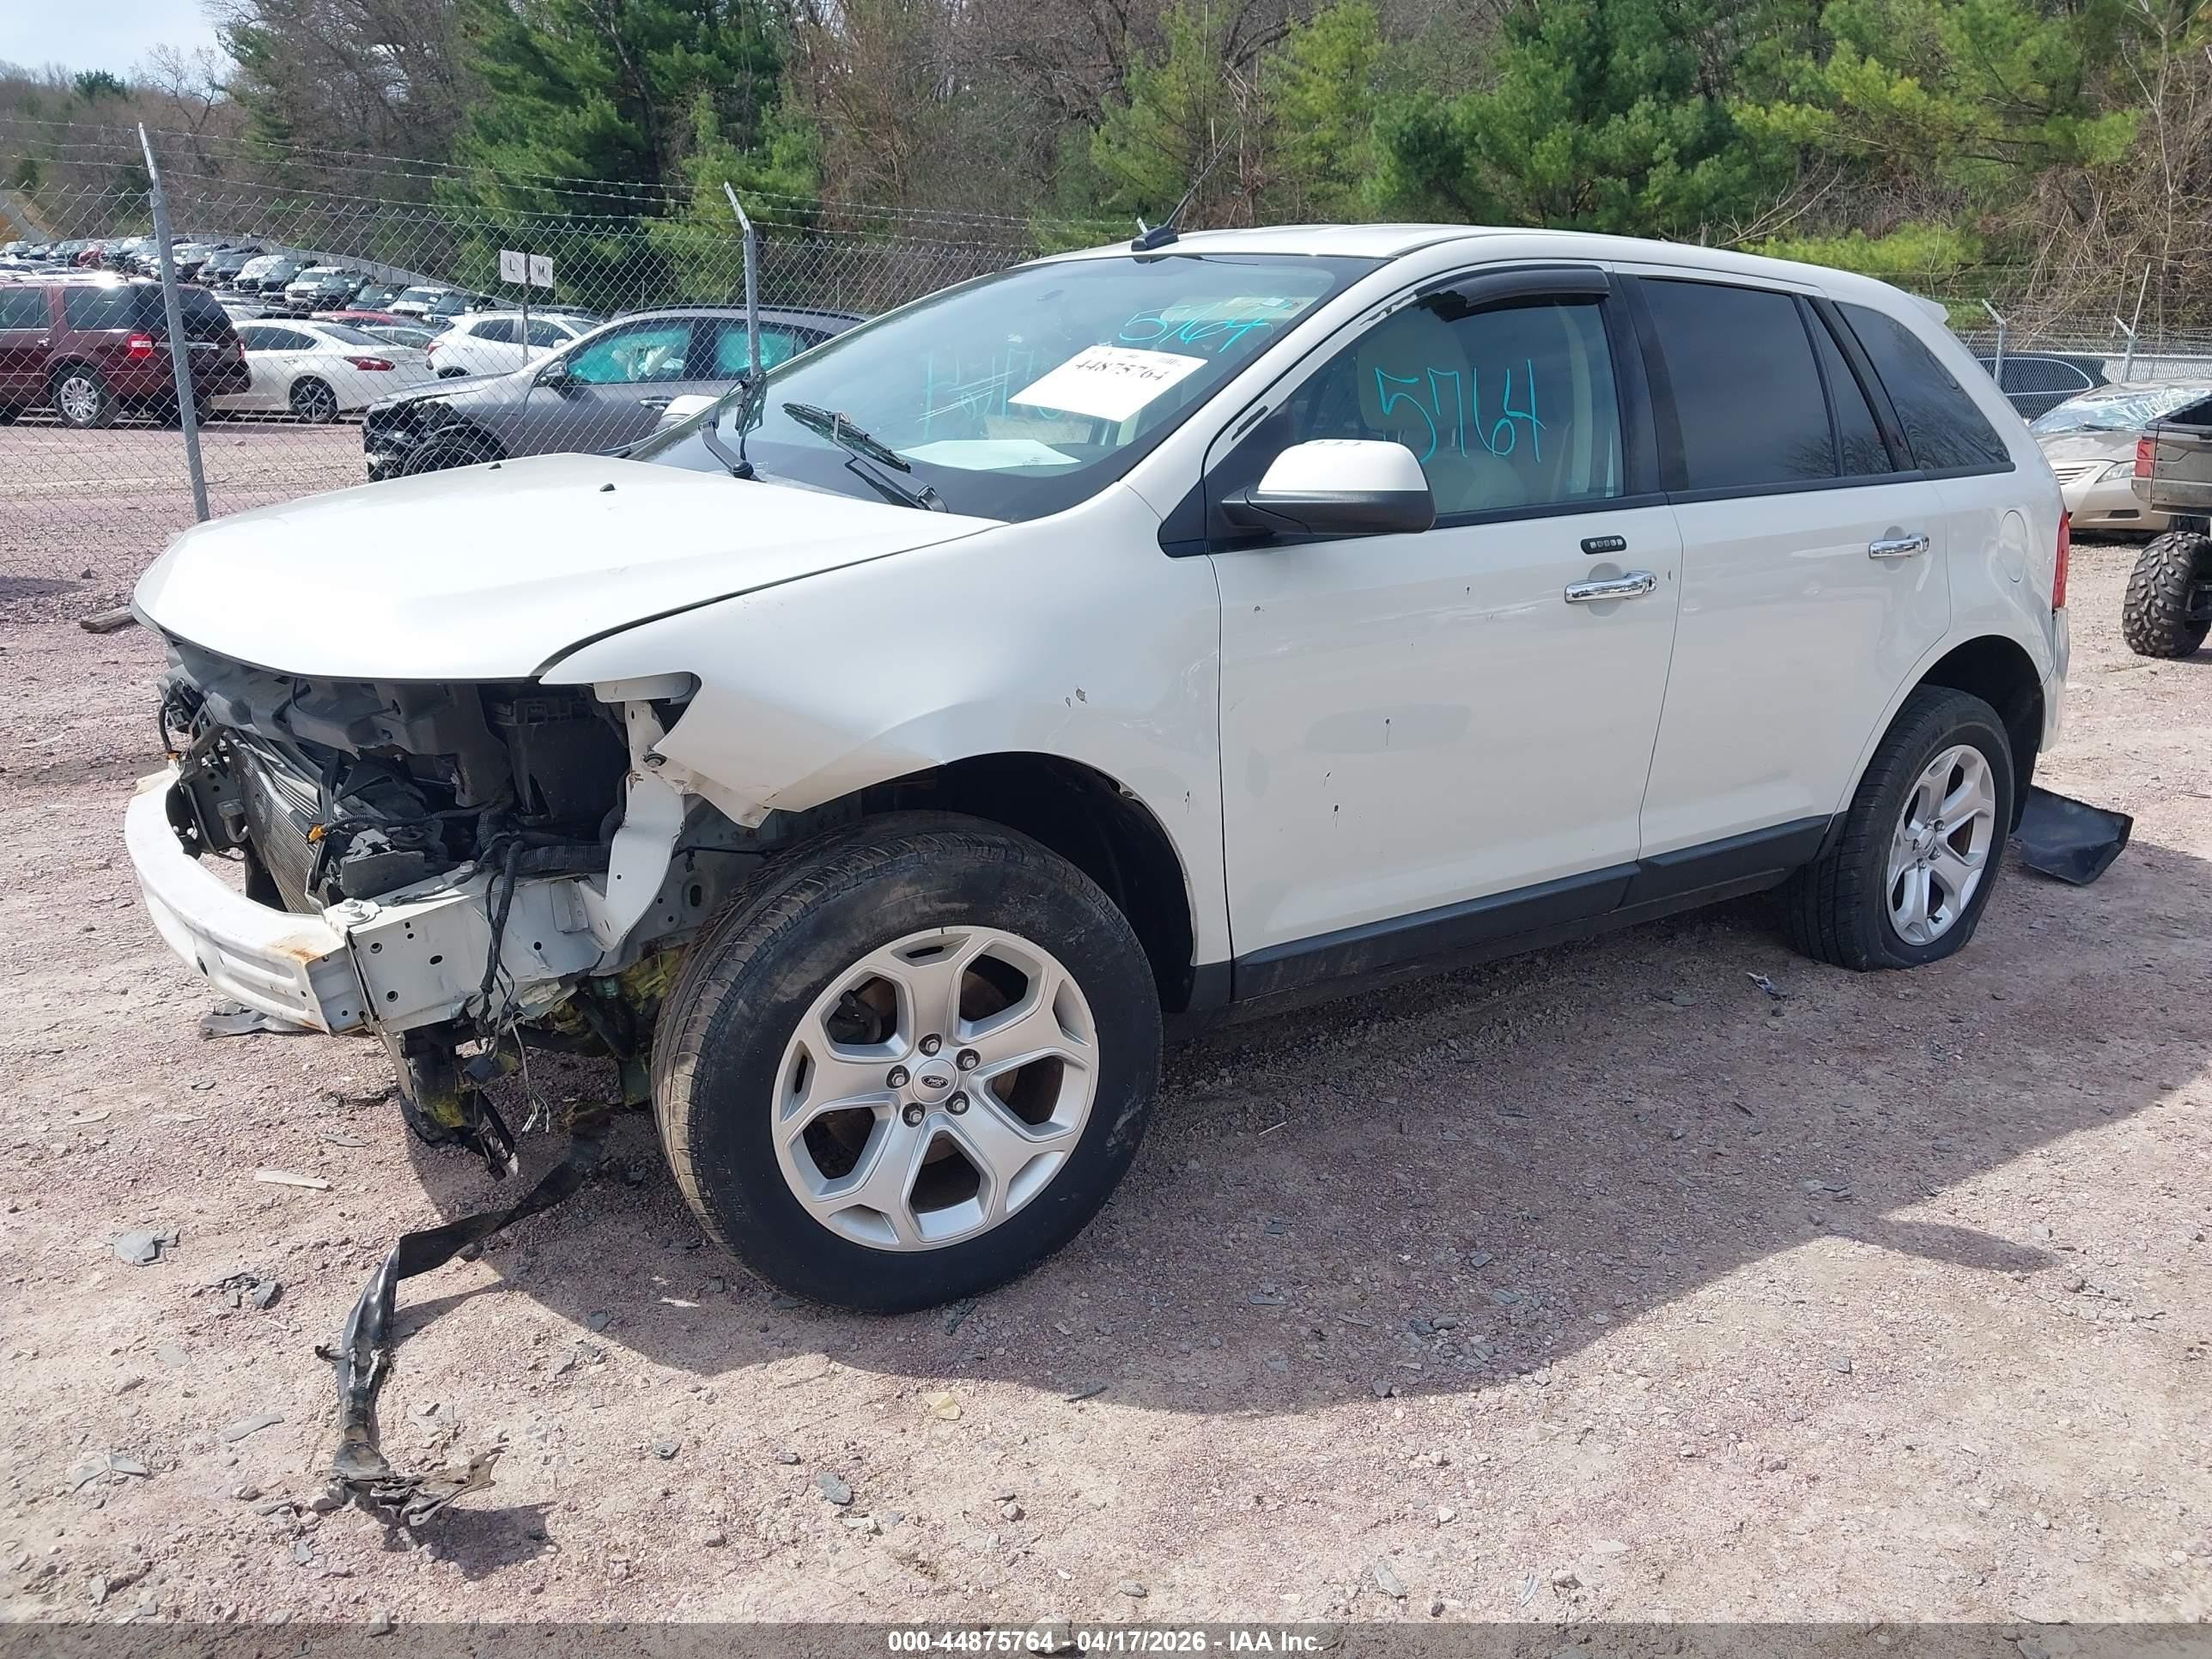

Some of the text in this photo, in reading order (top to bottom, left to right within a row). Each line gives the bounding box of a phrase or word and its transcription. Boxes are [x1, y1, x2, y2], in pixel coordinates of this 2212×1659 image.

[509, 258, 516, 271] L
[538, 265, 545, 276] M
[1375, 358, 1547, 463] 5764
